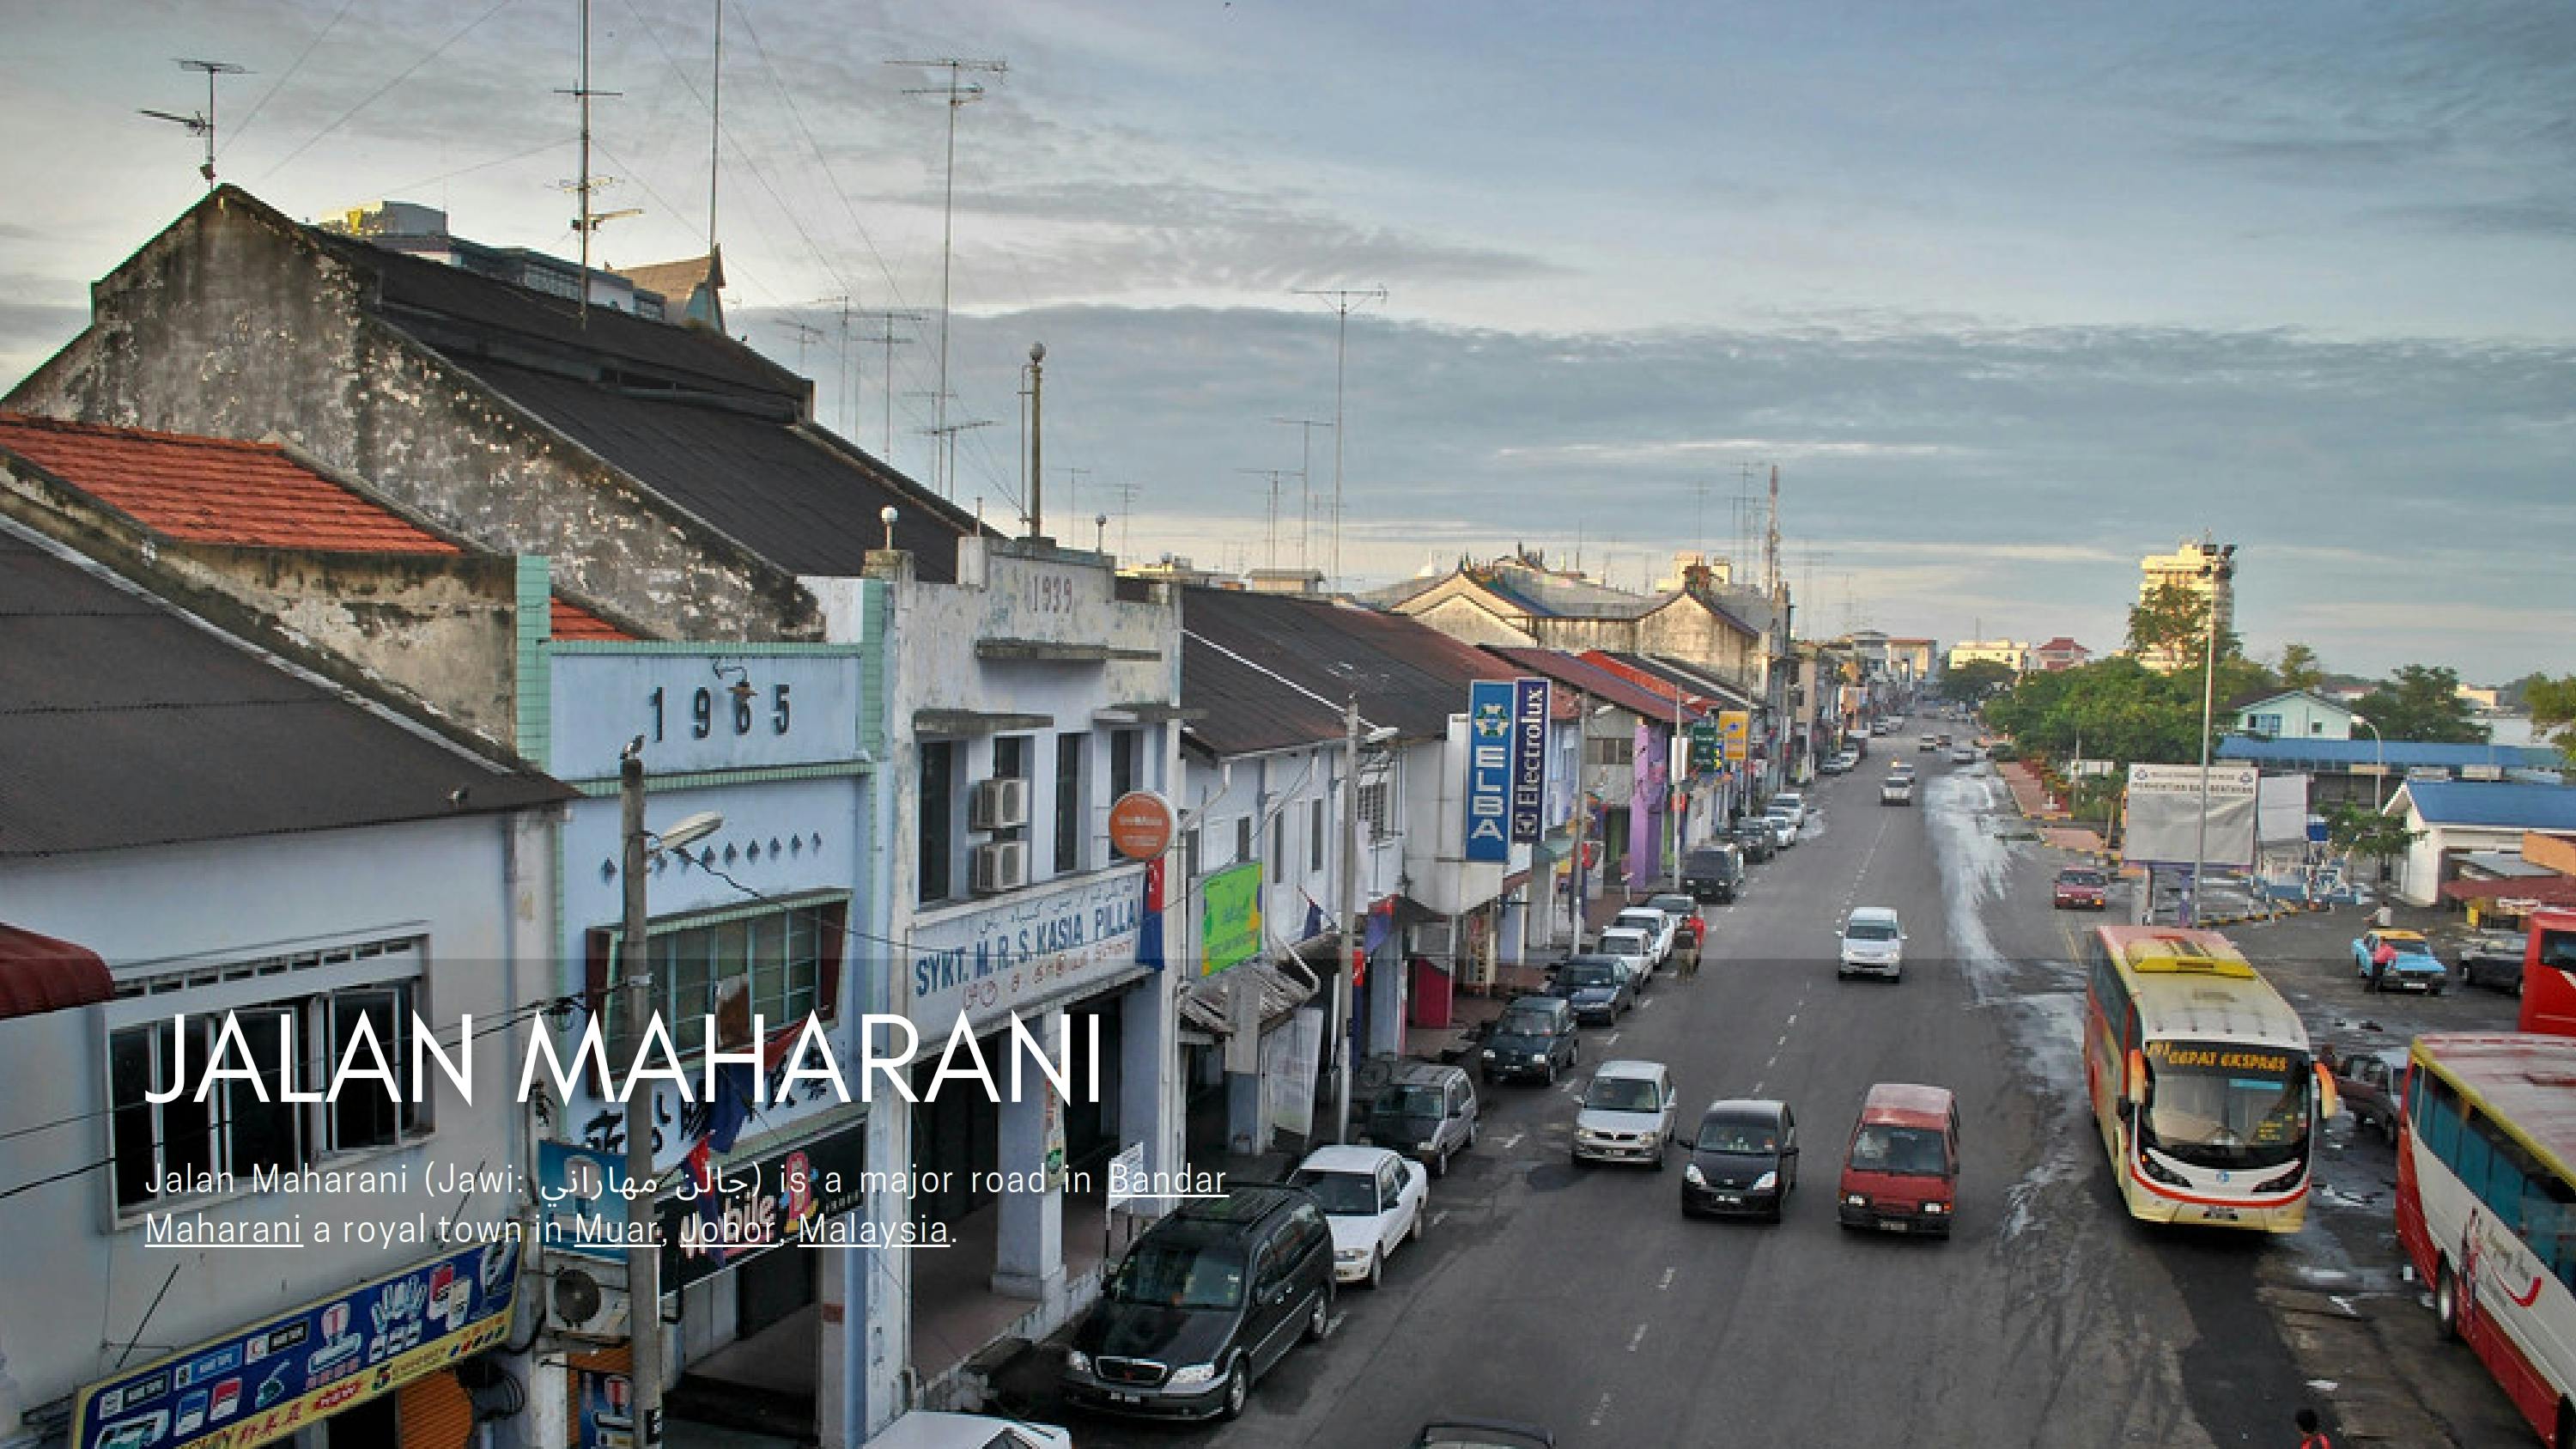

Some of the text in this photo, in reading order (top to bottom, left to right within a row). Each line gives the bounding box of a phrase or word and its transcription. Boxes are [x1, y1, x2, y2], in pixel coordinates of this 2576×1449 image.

[1033, 575, 1073, 614] 1939
[648, 684, 791, 742] 1965
[1517, 686, 1543, 807] Electrolux
[1471, 745, 1506, 842] ELBA
[915, 947, 969, 997] SYKT.
[1036, 914, 1084, 958] KASIA
[678, 1190, 776, 1259] Mbile
